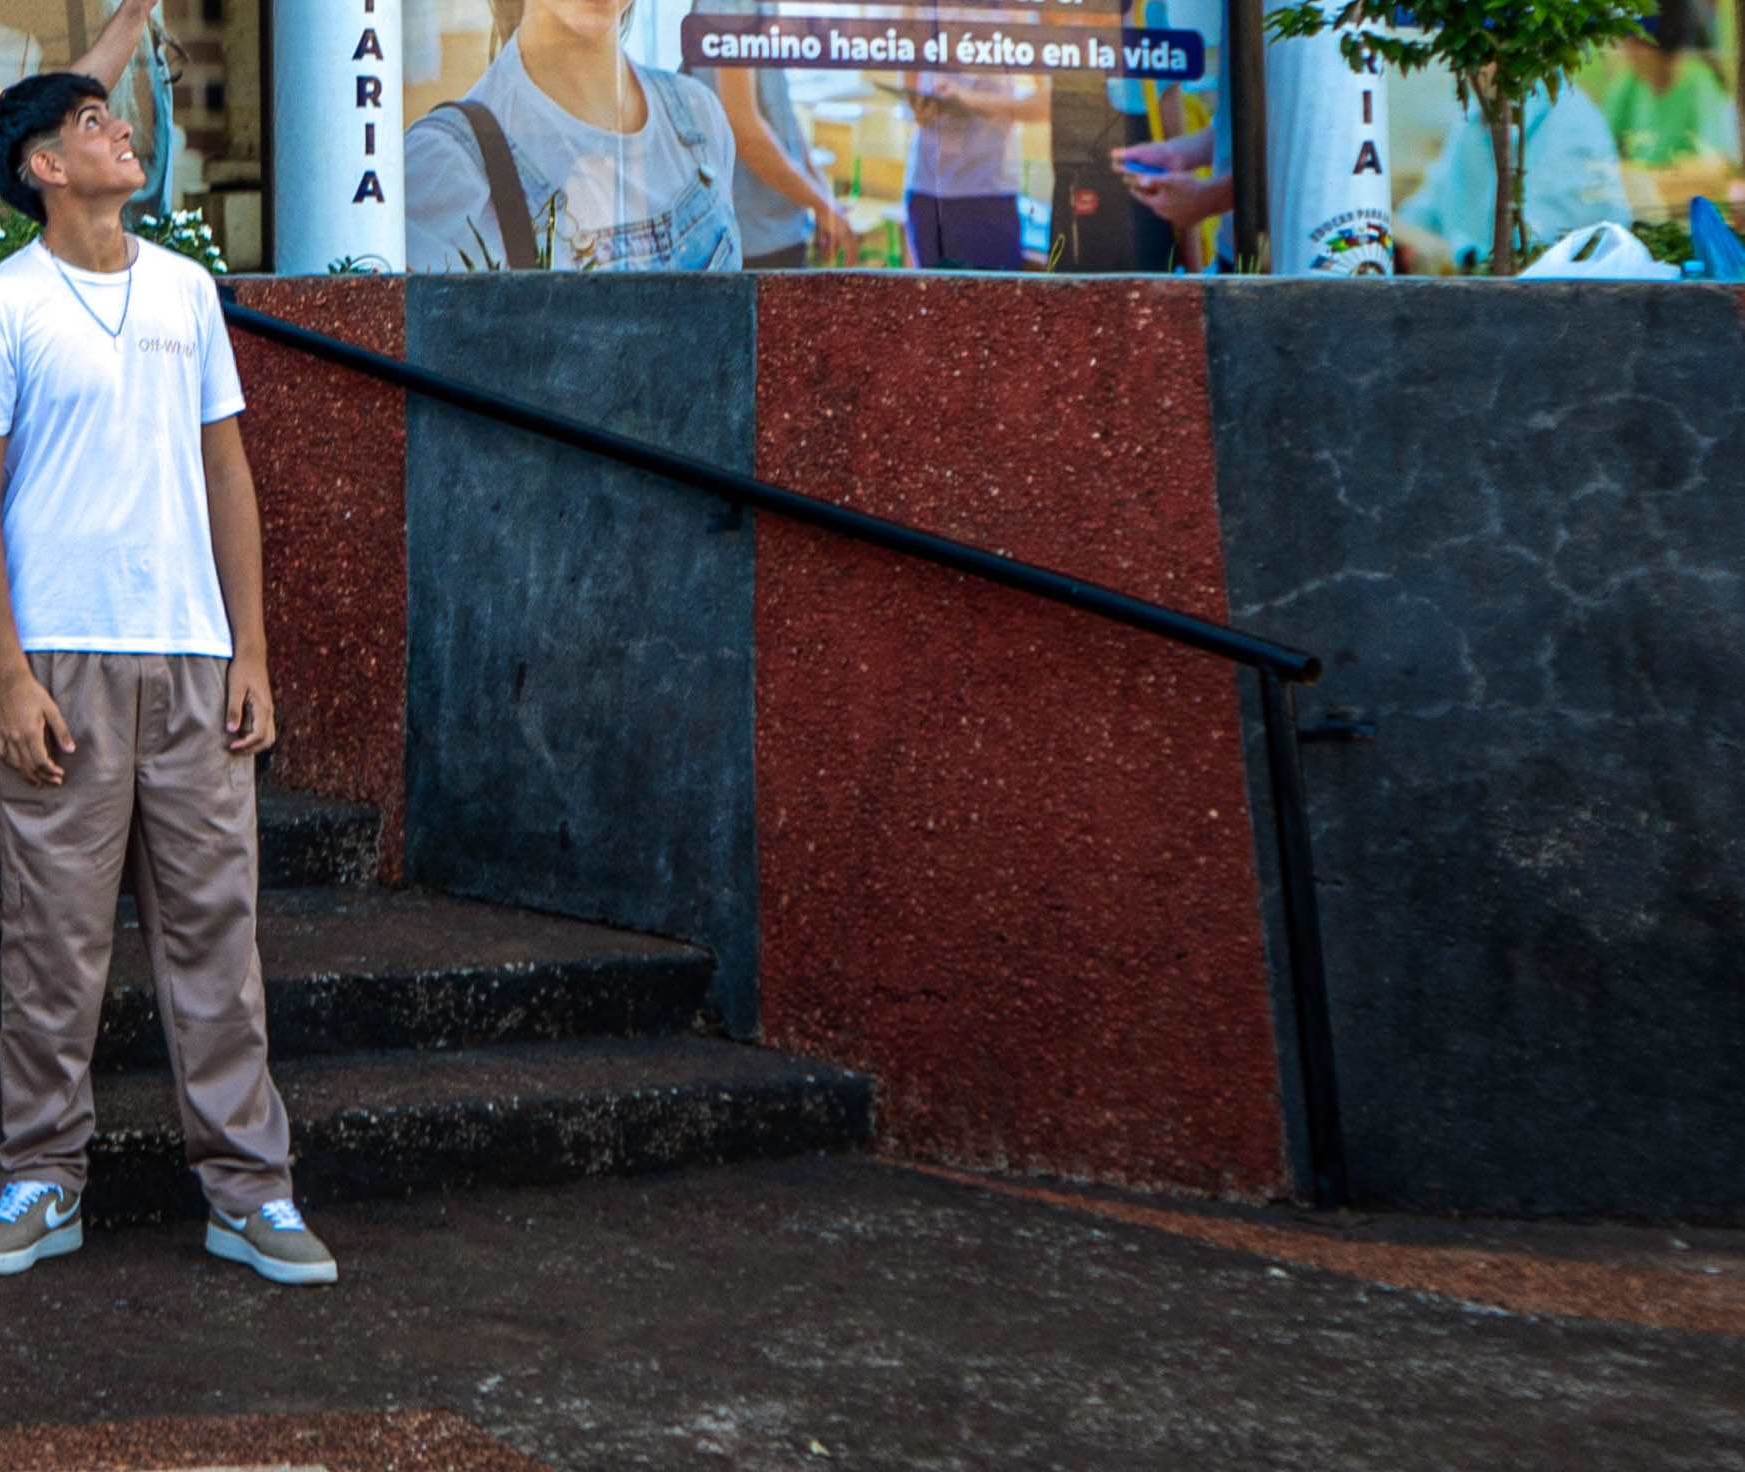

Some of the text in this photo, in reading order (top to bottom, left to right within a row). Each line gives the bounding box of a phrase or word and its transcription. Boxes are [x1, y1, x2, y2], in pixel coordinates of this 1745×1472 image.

[701, 26, 1187, 72] camino hacia el éxito en la vida
